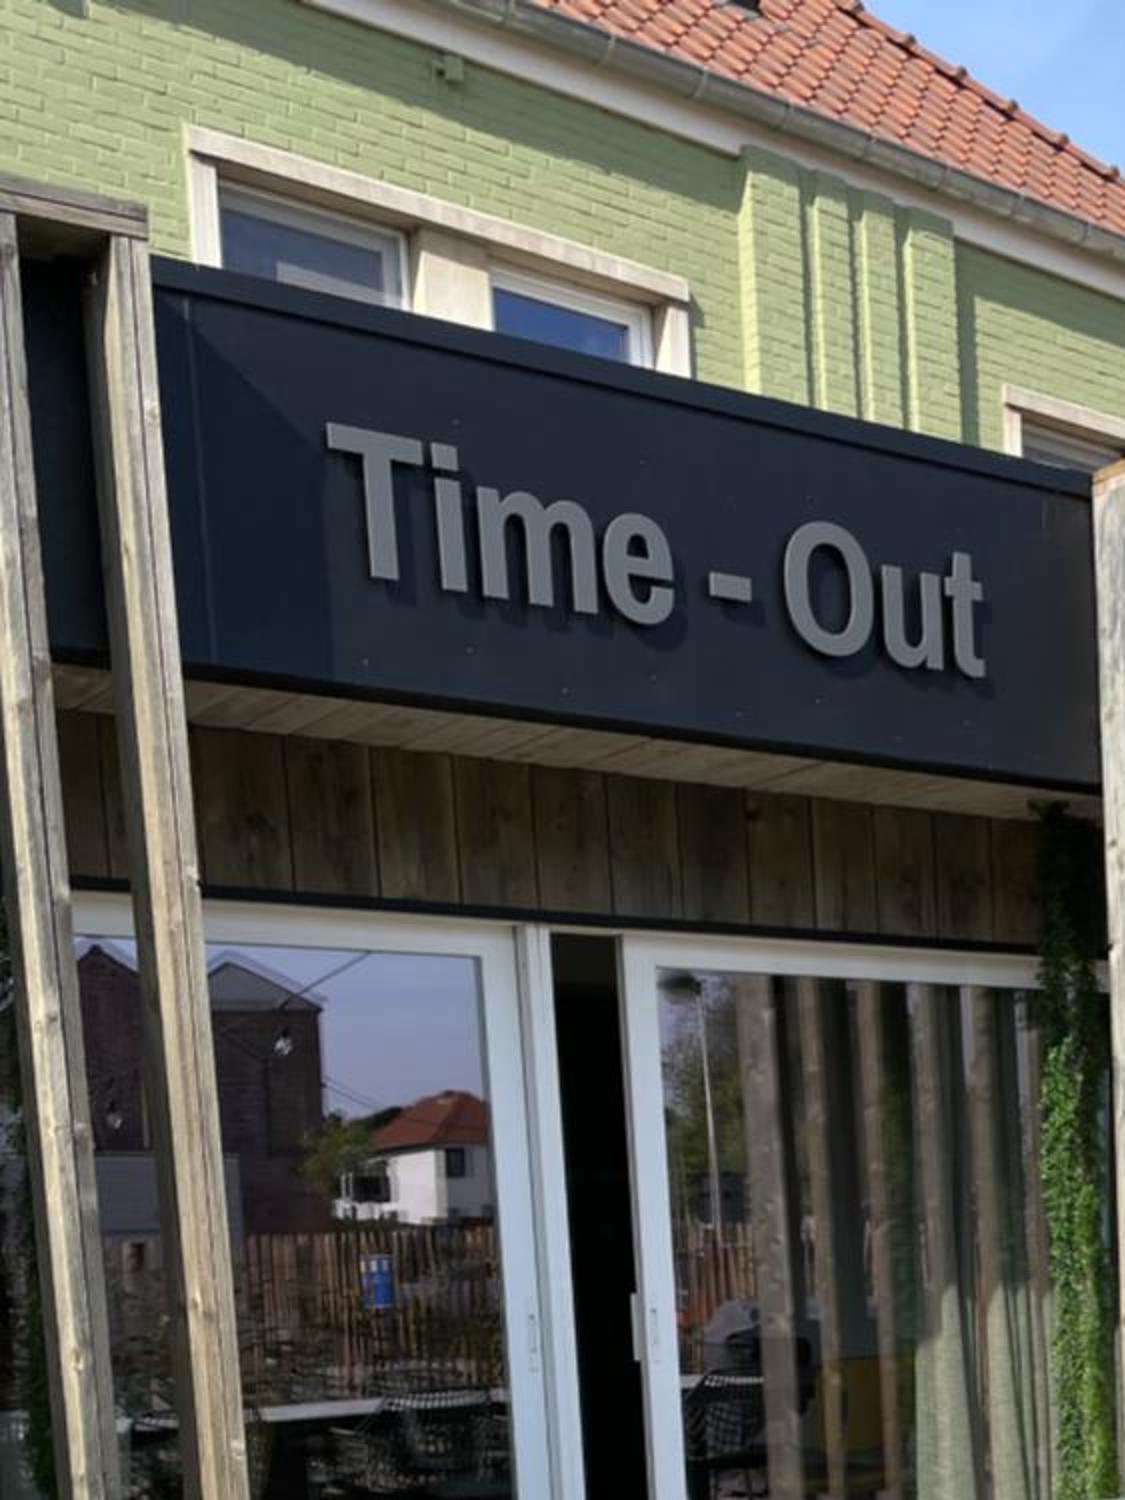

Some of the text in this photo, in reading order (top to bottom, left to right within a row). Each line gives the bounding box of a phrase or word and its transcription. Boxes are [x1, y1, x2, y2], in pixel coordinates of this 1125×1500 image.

[326, 421, 986, 678] Time - Out
